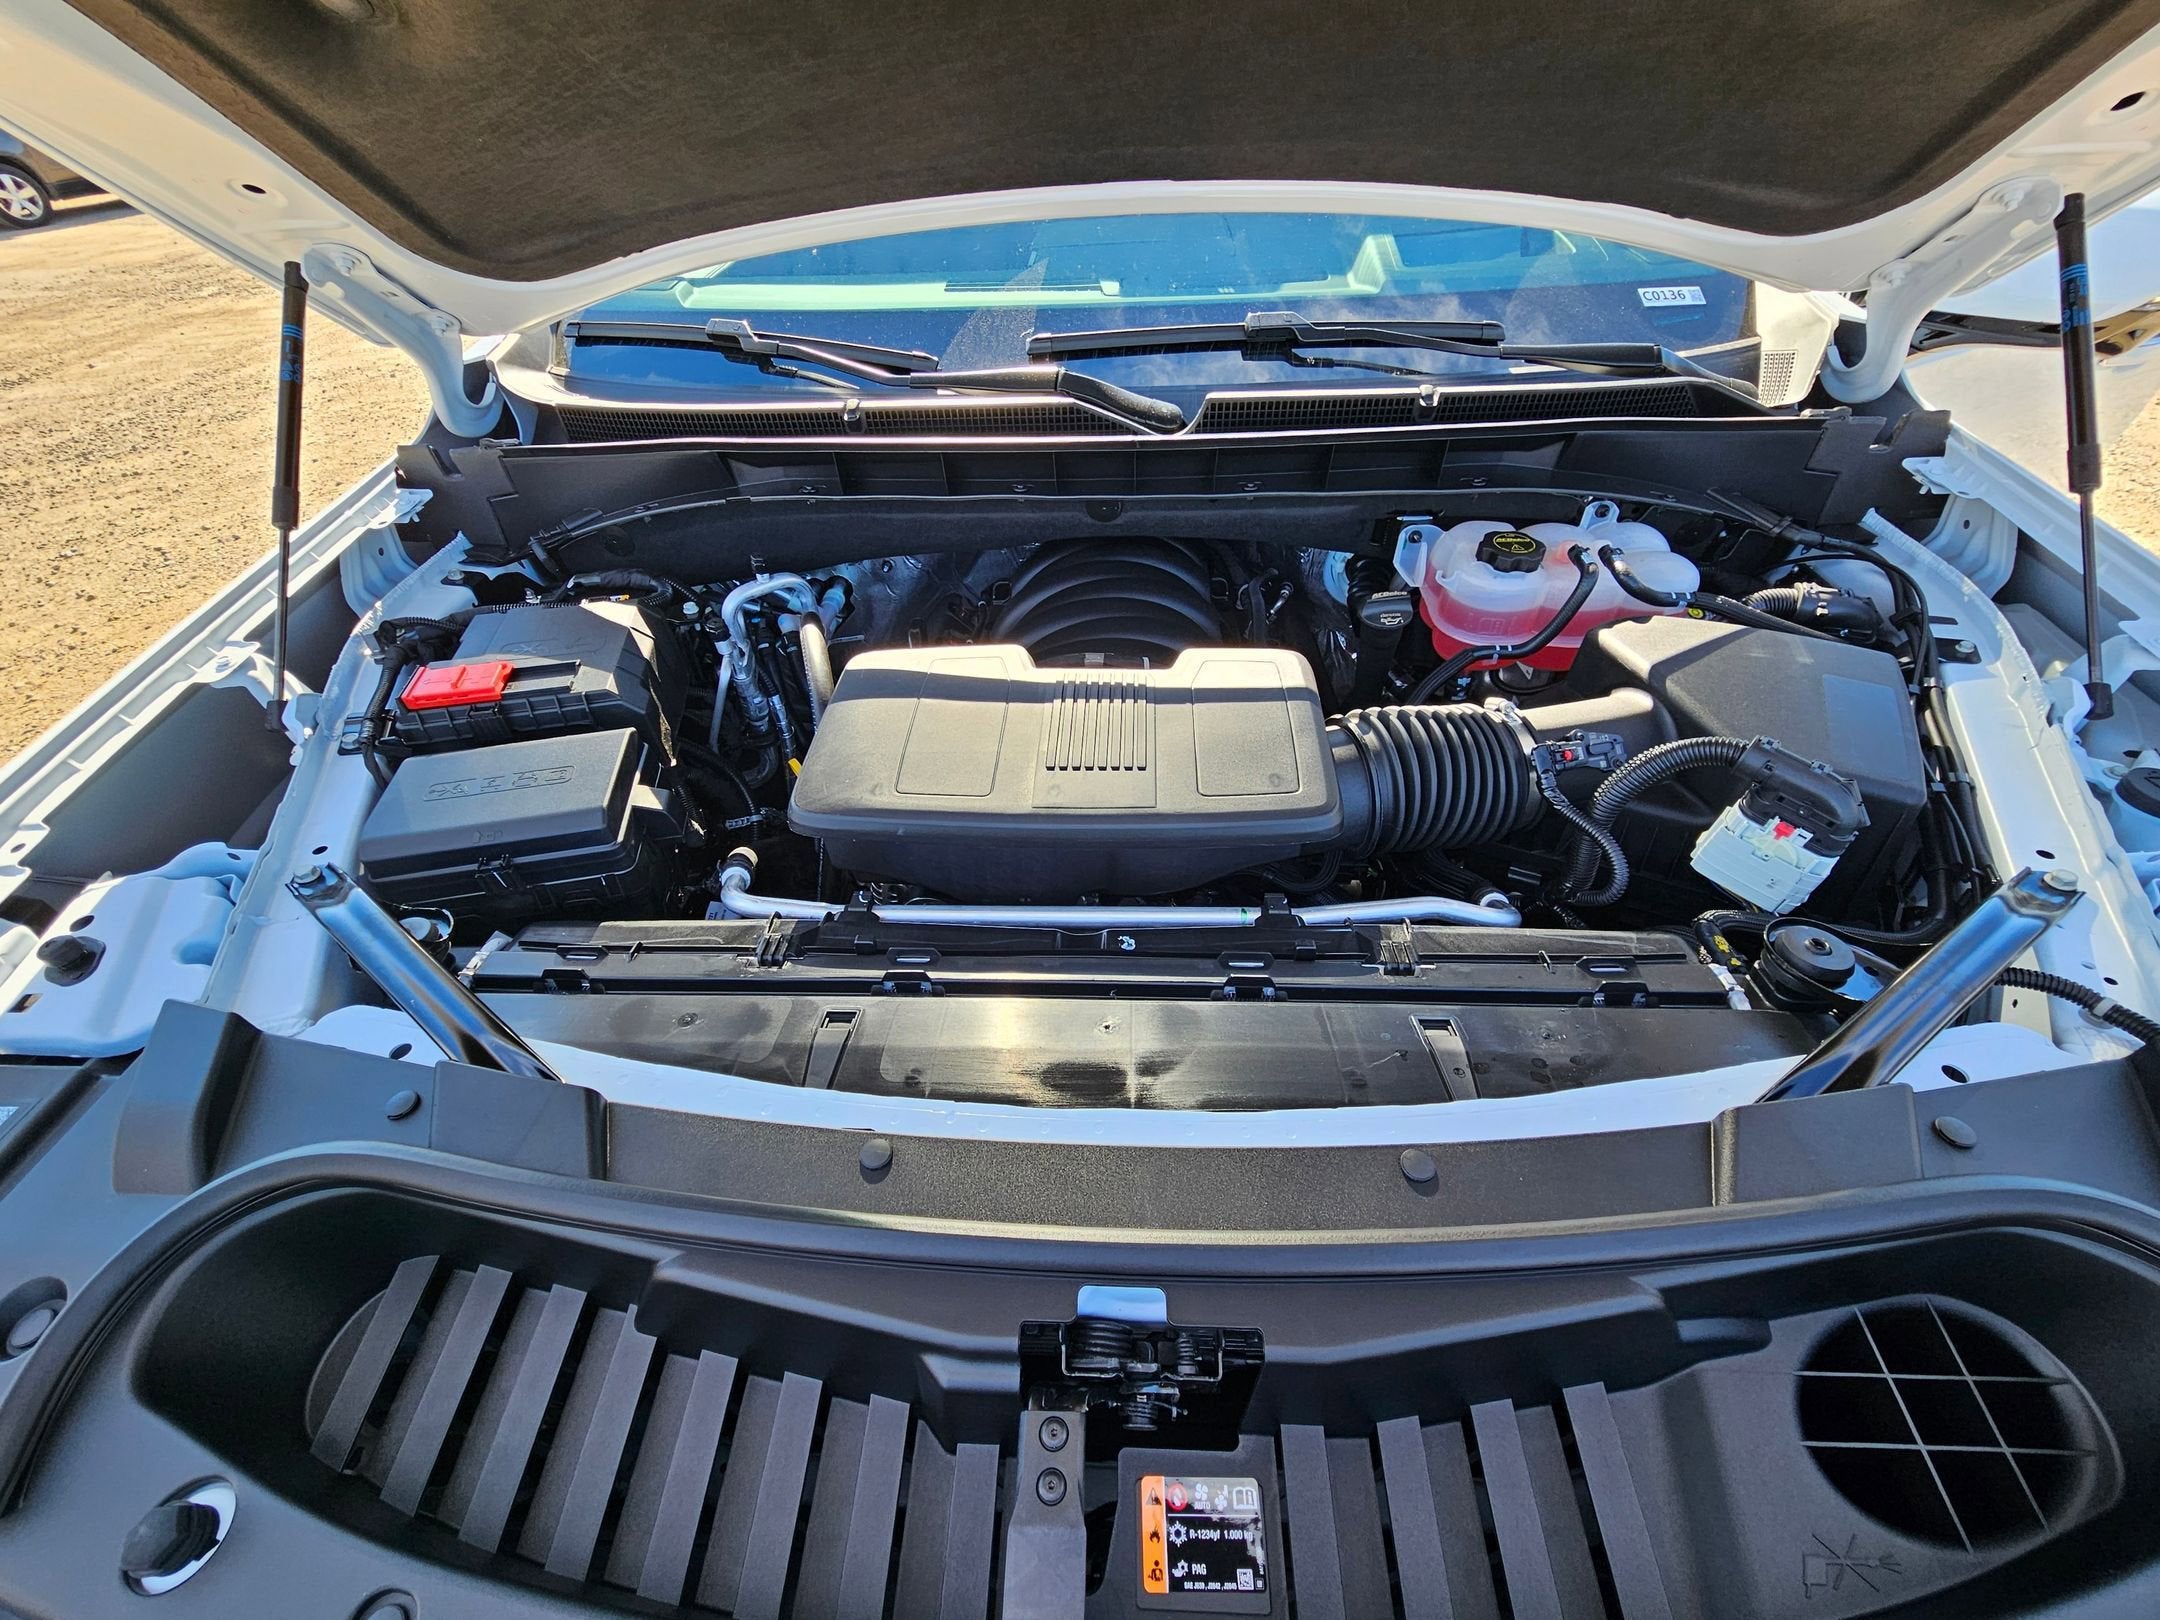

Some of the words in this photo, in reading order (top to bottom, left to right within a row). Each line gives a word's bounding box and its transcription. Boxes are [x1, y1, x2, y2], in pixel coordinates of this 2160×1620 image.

[1642, 289, 1686, 301] C0136
[1194, 1501, 1211, 1510] AUTO
[1189, 1529, 1220, 1542] R-1234yf
[1223, 1529, 1243, 1540] 1.000
[1243, 1530, 1254, 1542] kg
[1191, 1563, 1207, 1576] PAG
